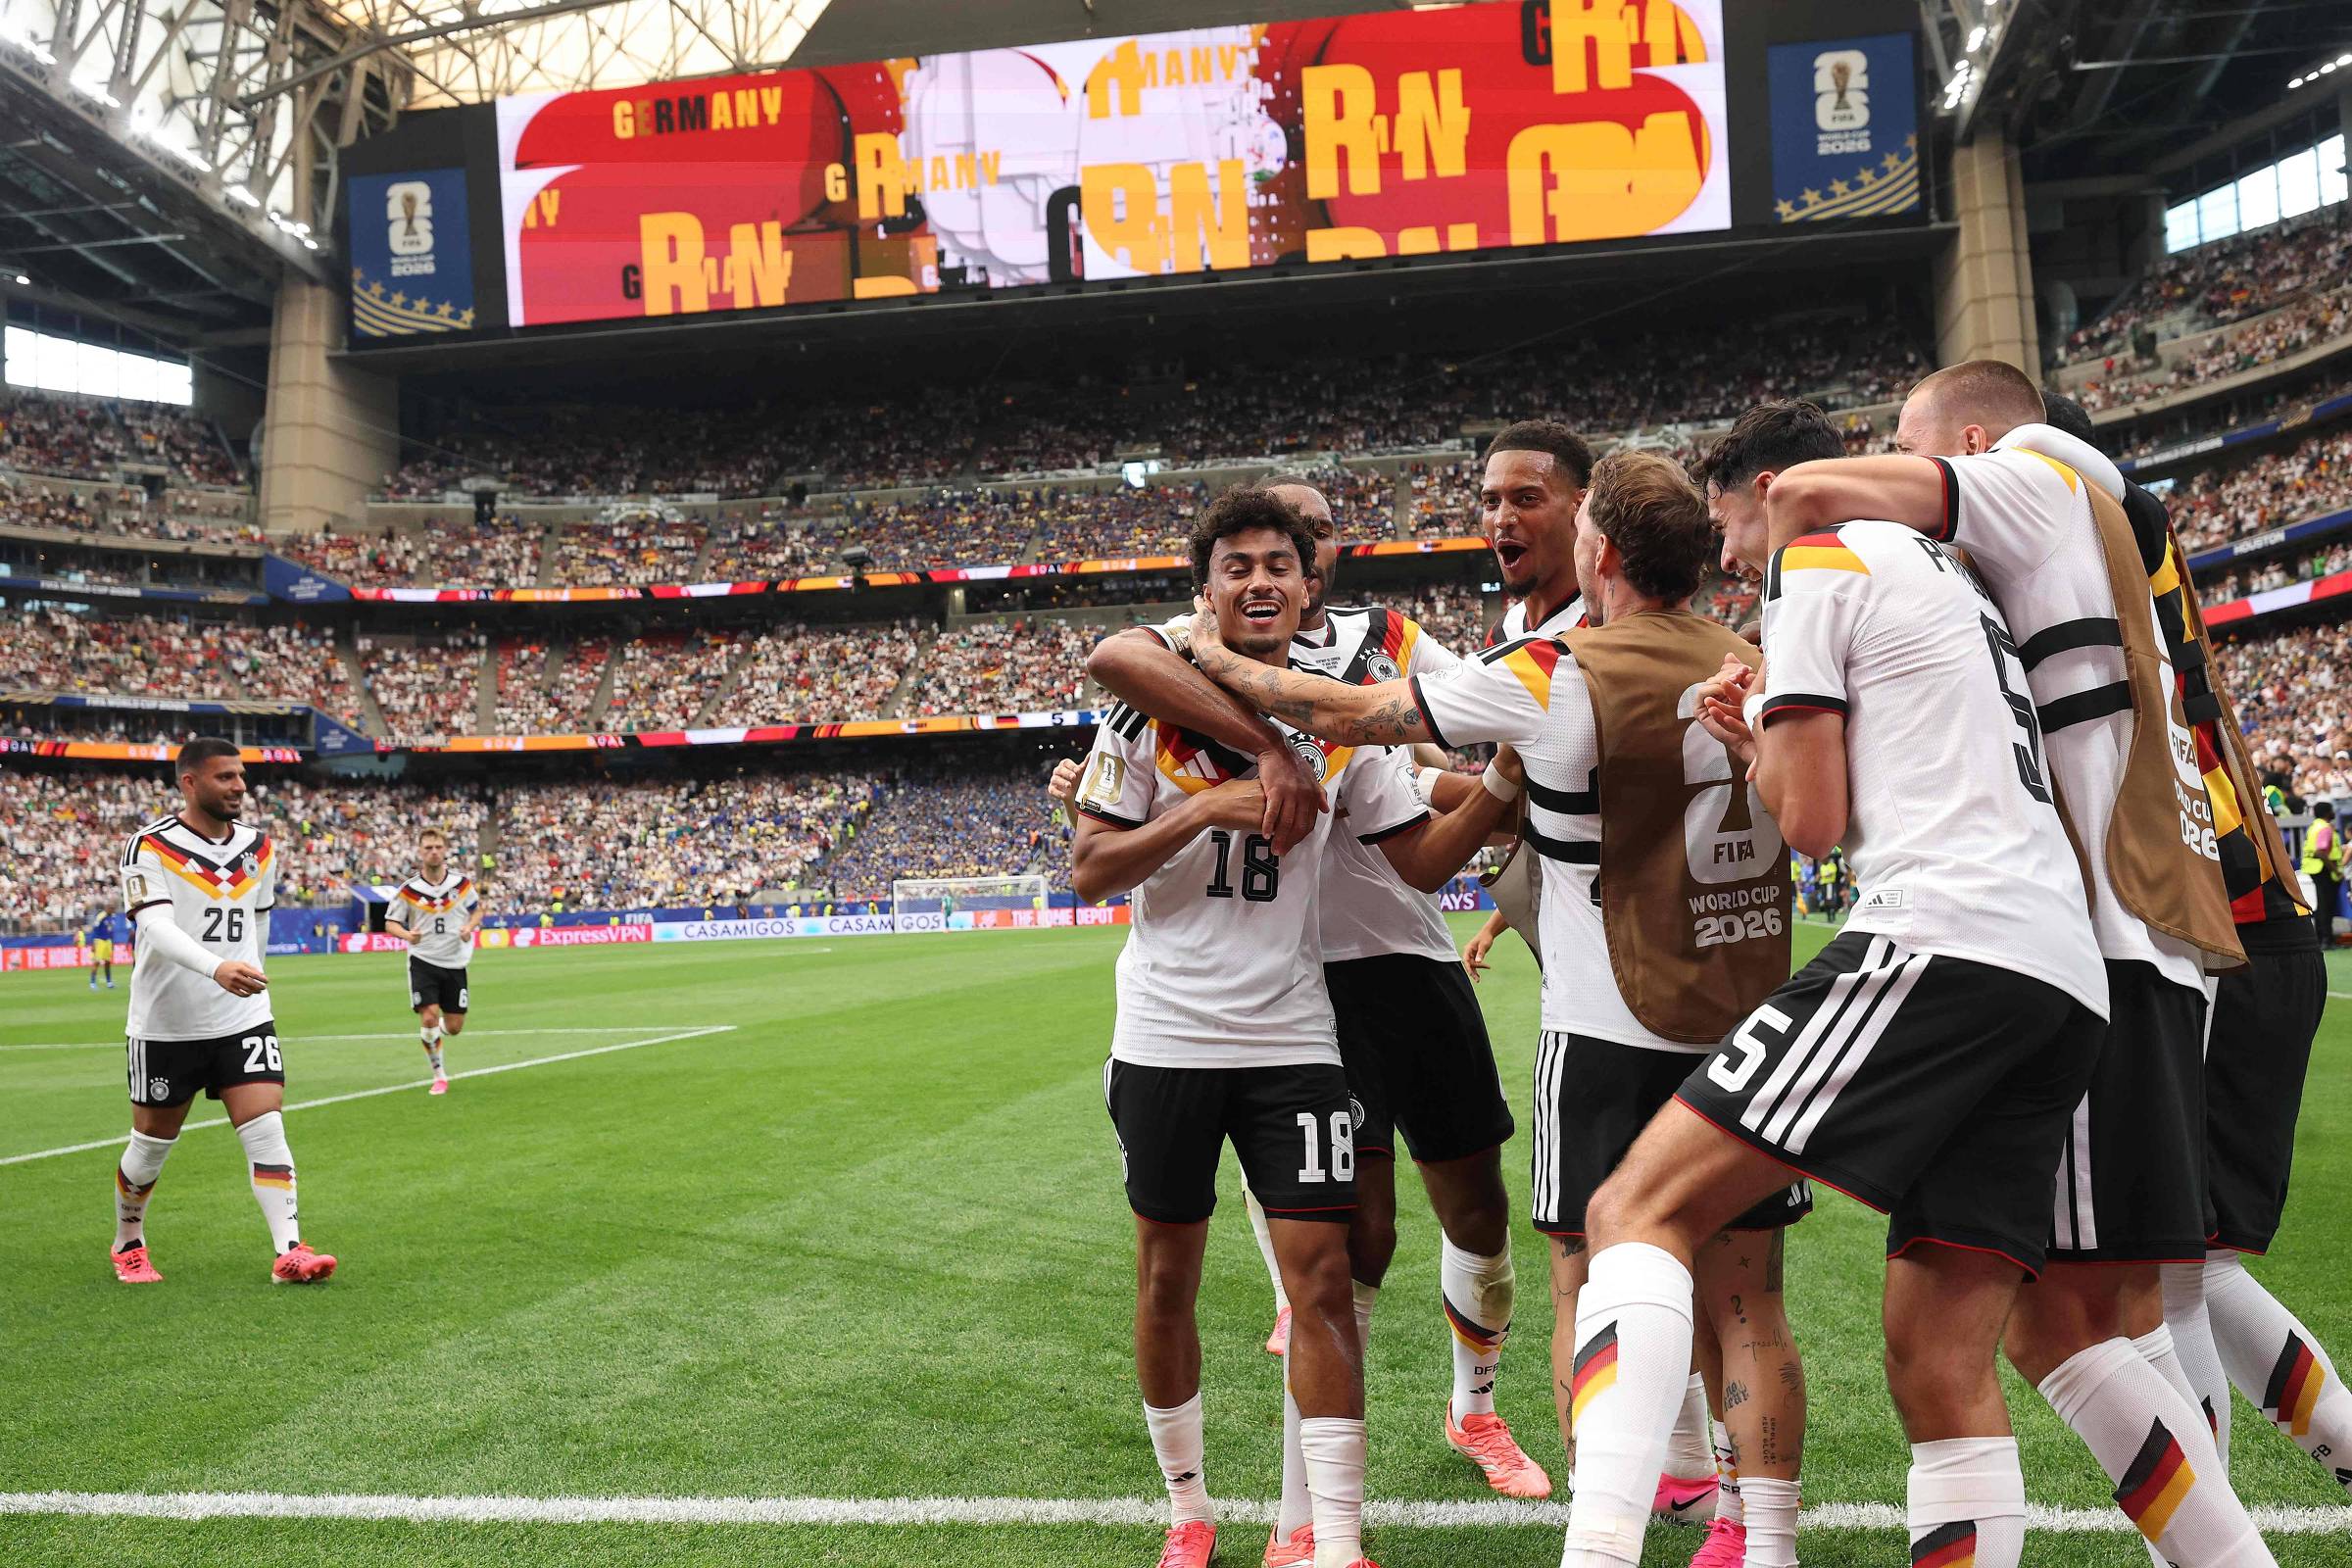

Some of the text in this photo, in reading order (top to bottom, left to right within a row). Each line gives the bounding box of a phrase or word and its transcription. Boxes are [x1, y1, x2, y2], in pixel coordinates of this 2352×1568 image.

[612, 86, 782, 139] GERMANY
[1817, 138, 1871, 156] 2026
[391, 261, 436, 276] 2026
[2233, 530, 2285, 556] HOUSTON
[1052, 712, 1064, 727] 5
[1980, 610, 2054, 806] 5
[1713, 839, 1755, 863] FIFA
[1206, 831, 1279, 903] 18
[1439, 893, 1474, 910] AYS
[1688, 886, 1780, 914] WORLD CUP
[202, 907, 244, 942] 26
[434, 917, 446, 934] 6
[624, 912, 654, 924] FIFA
[1012, 909, 1034, 926] THE
[1076, 906, 1114, 925] DEPOT
[1693, 907, 1783, 948] 2026
[540, 923, 647, 946] ExpressVPN
[685, 921, 795, 938] CASAMIGOS
[27, 948, 47, 968] THE
[48, 946, 78, 967] HOME
[459, 988, 468, 1008] 6
[242, 1036, 282, 1073] 26
[1707, 1004, 1793, 1093] 5
[1297, 1111, 1354, 1183] 18
[1474, 1362, 1498, 1375] DFB
